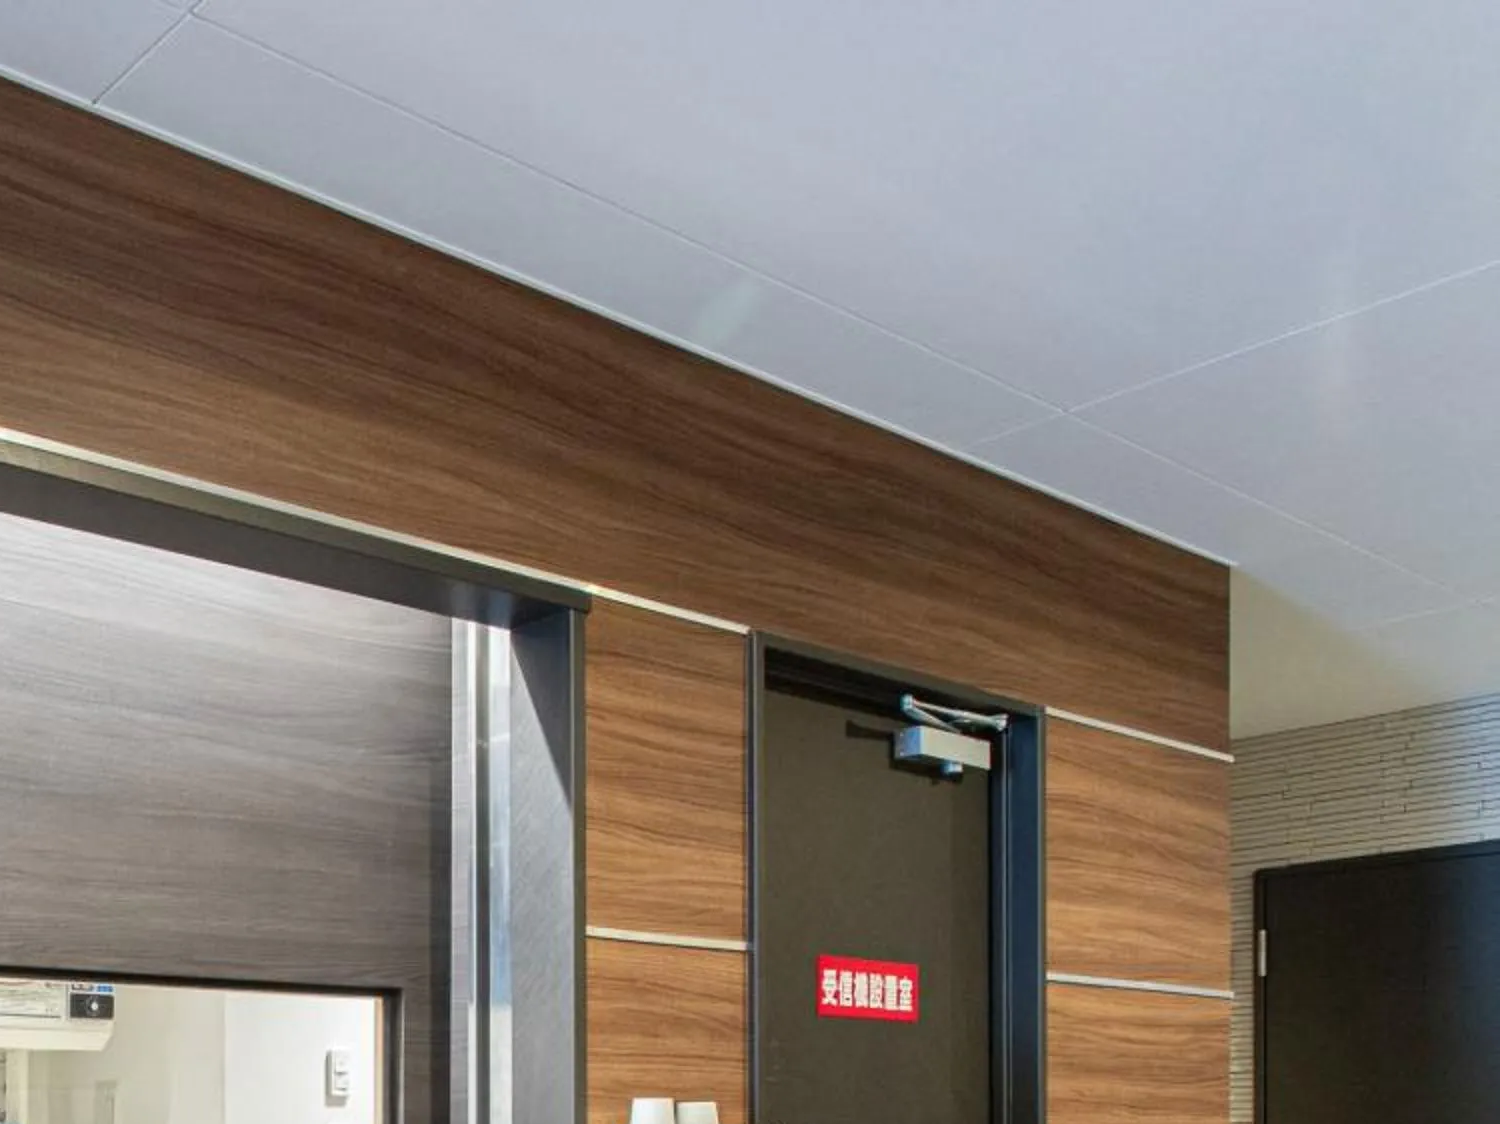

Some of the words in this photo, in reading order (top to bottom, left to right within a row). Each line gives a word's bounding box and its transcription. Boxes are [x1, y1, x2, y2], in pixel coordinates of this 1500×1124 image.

[822, 969, 912, 1011] 受信機設置室
